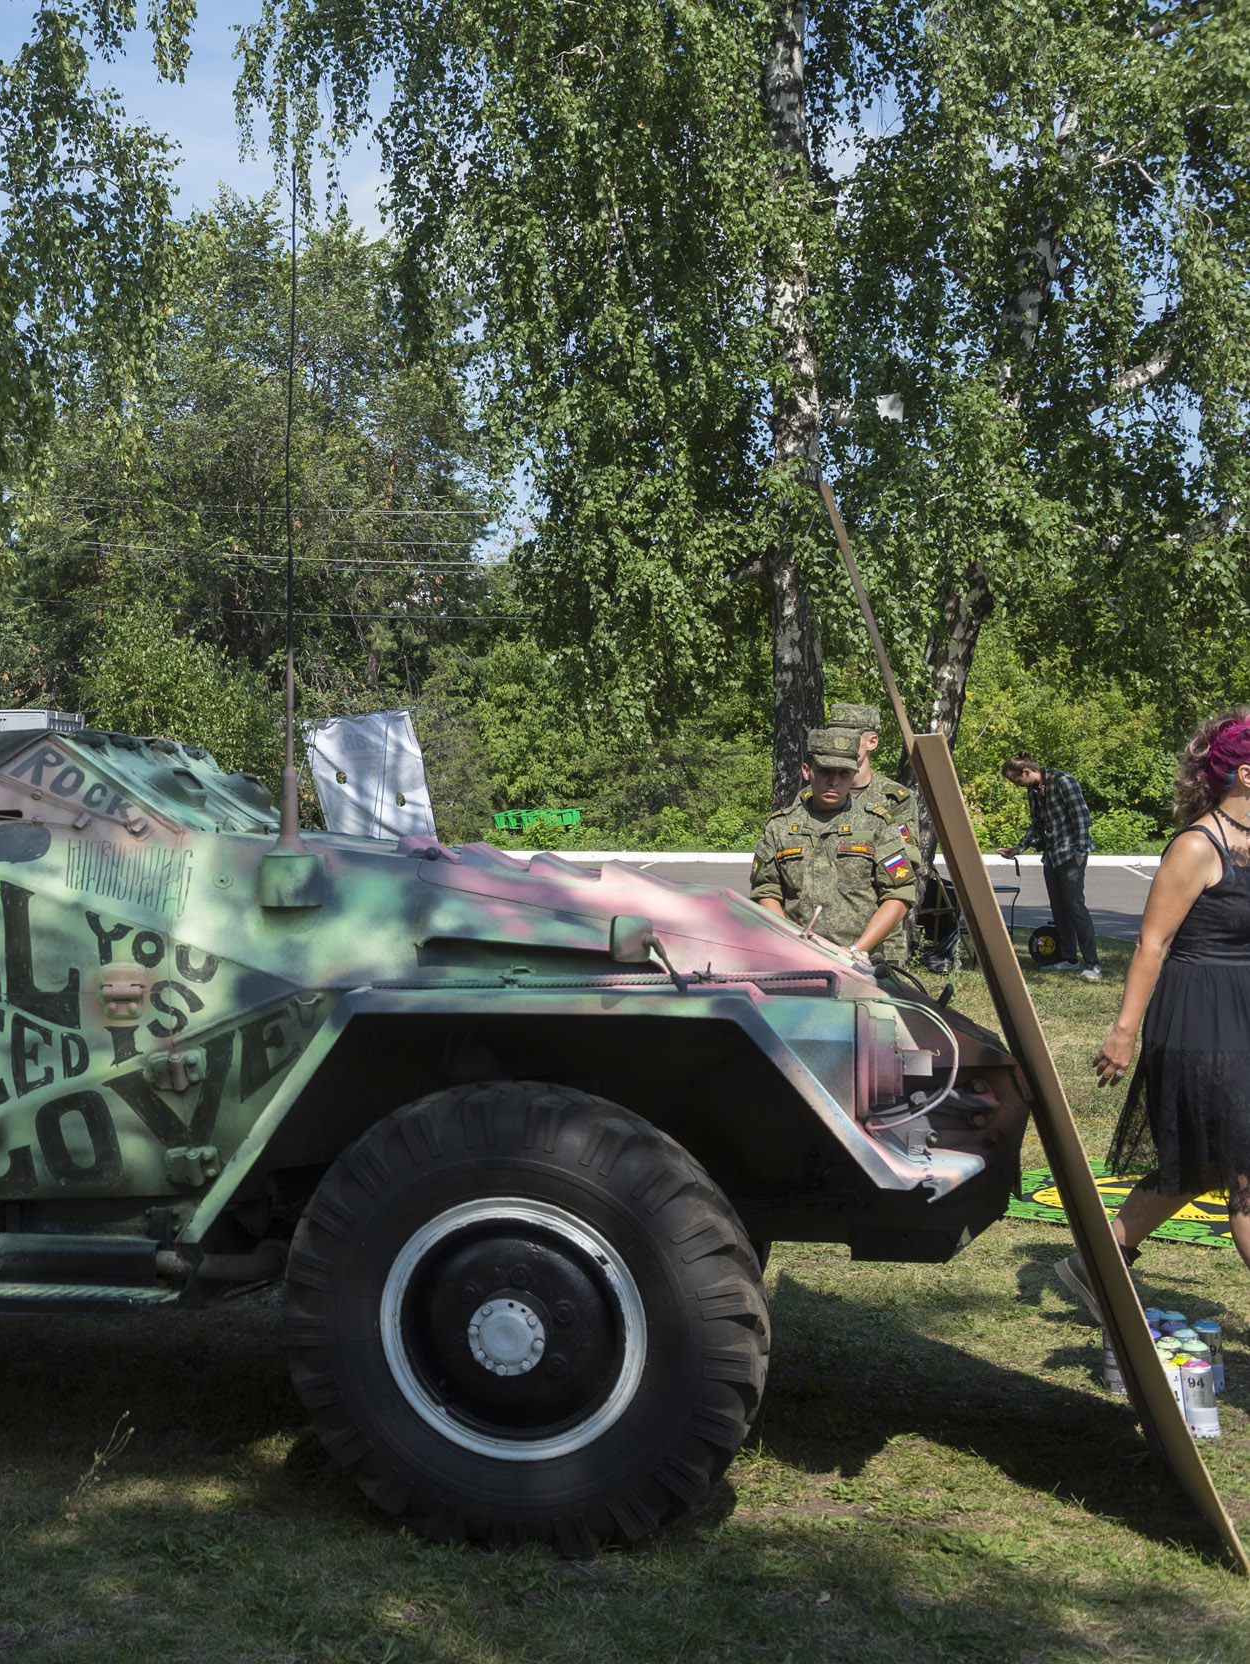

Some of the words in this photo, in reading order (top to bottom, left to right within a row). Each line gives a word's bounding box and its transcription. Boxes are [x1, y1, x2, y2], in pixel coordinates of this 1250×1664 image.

[9, 746, 134, 822] ROCK
[85, 910, 221, 983] YOU
[103, 980, 205, 1067] IS
[1187, 1377, 1205, 1389] 94
